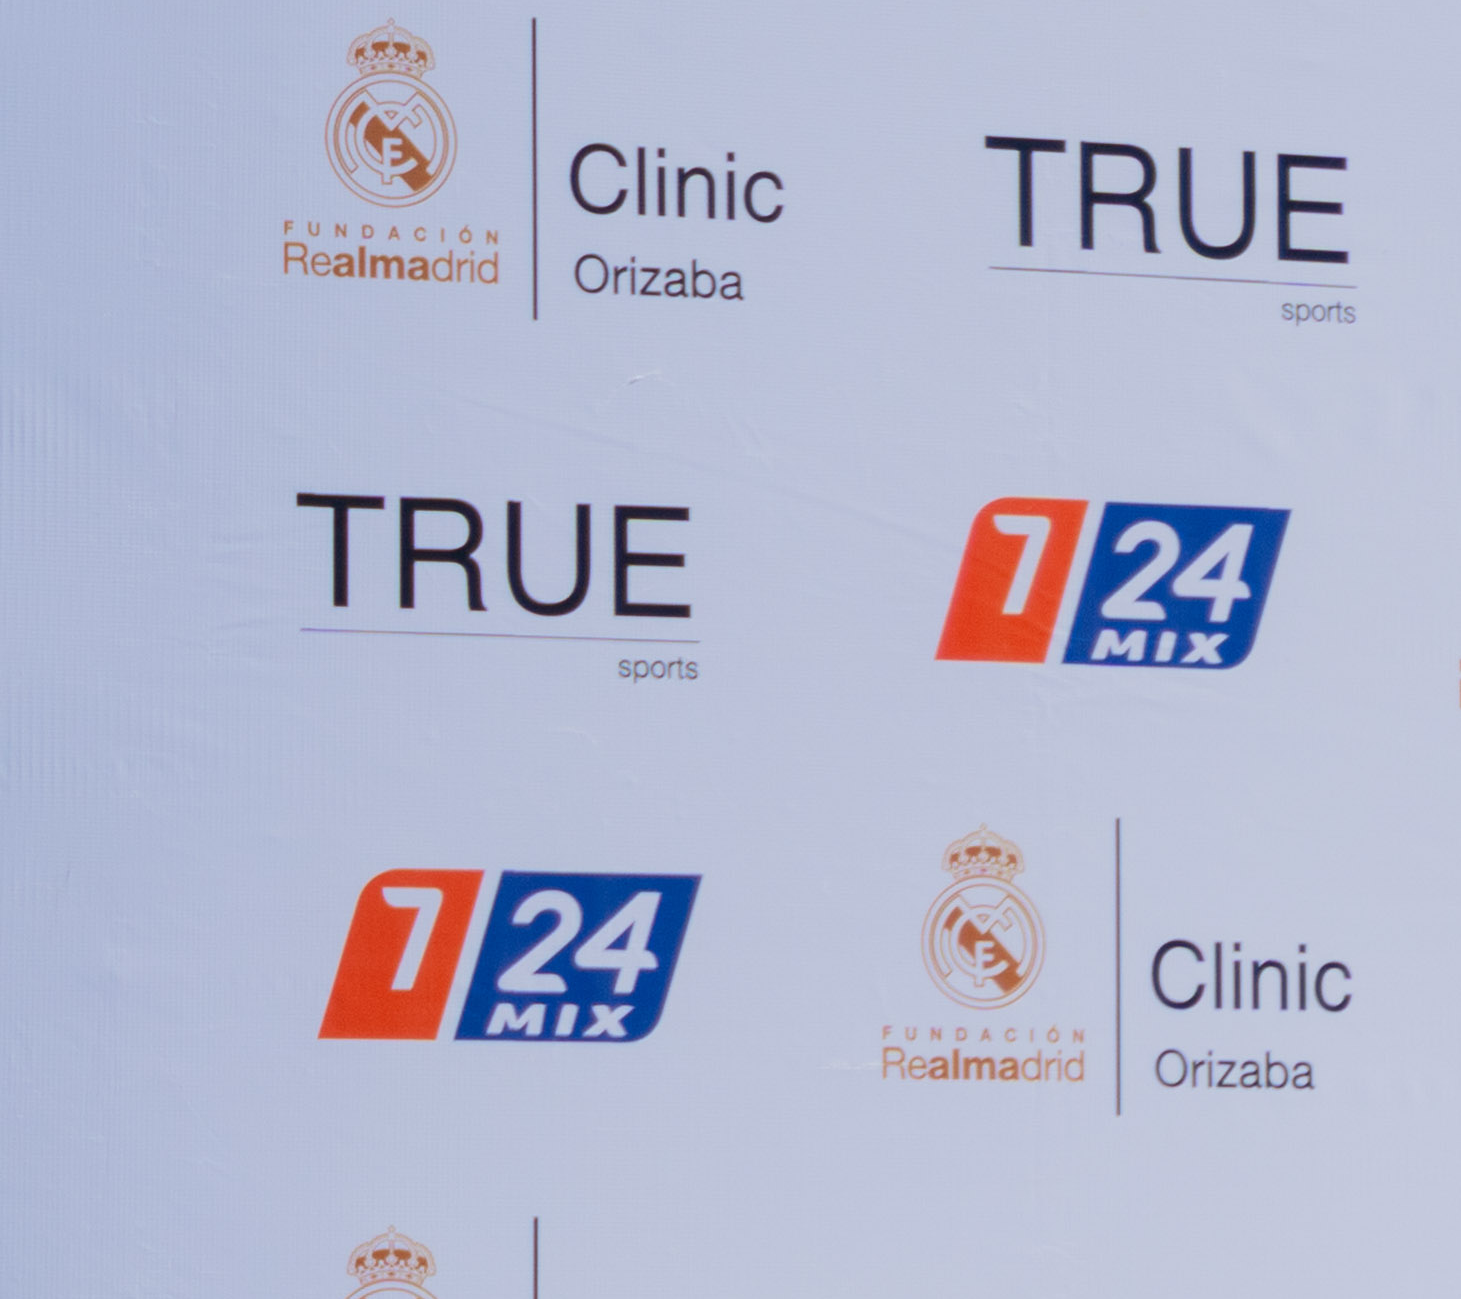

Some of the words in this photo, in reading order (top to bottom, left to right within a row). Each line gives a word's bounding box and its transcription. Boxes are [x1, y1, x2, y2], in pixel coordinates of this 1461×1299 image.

[570, 143, 783, 223] Clinic
[985, 136, 1348, 263] TRUE
[284, 220, 498, 244] FUNDACIÓN
[284, 242, 498, 284] Realmadrid
[575, 254, 743, 300] Orizaba
[1282, 302, 1356, 326] sports
[297, 493, 690, 618] TRUE
[1100, 520, 1253, 623] 24
[1090, 629, 1230, 667] MIX
[619, 658, 698, 683] sports
[496, 889, 661, 995] 24
[1152, 940, 1351, 1012] Clinic
[483, 999, 635, 1040] MIX
[882, 1025, 1084, 1043] FUNDACIÓN
[883, 1046, 1084, 1081] Realmadrid
[1156, 1049, 1314, 1089] Orizaba
